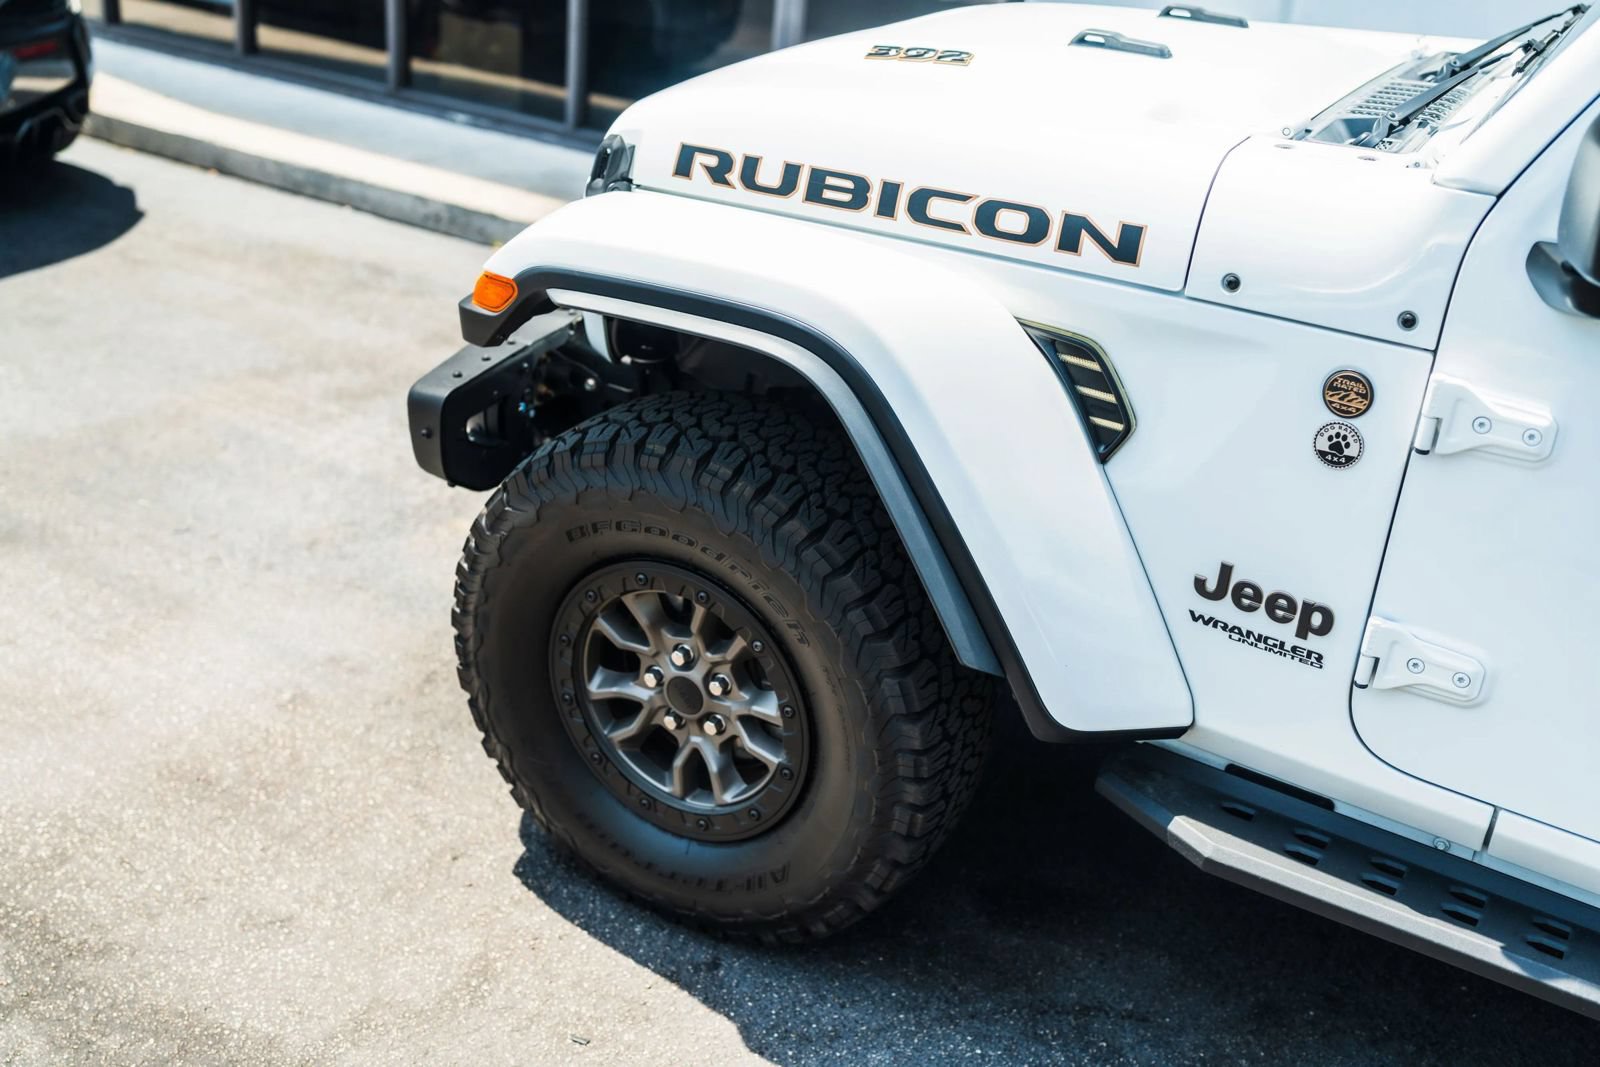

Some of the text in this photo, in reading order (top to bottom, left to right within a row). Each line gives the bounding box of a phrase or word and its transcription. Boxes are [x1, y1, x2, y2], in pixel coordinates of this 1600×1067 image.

[864, 45, 975, 66] 392
[671, 141, 1148, 267] RUBICON
[1333, 381, 1367, 394] RATED
[1337, 377, 1366, 389] TRAIL
[1319, 425, 1358, 444] DOG RATED
[1193, 560, 1335, 641] Jeep
[1188, 609, 1324, 664] WRANGLER
[1228, 634, 1324, 670] UNLIMITED
